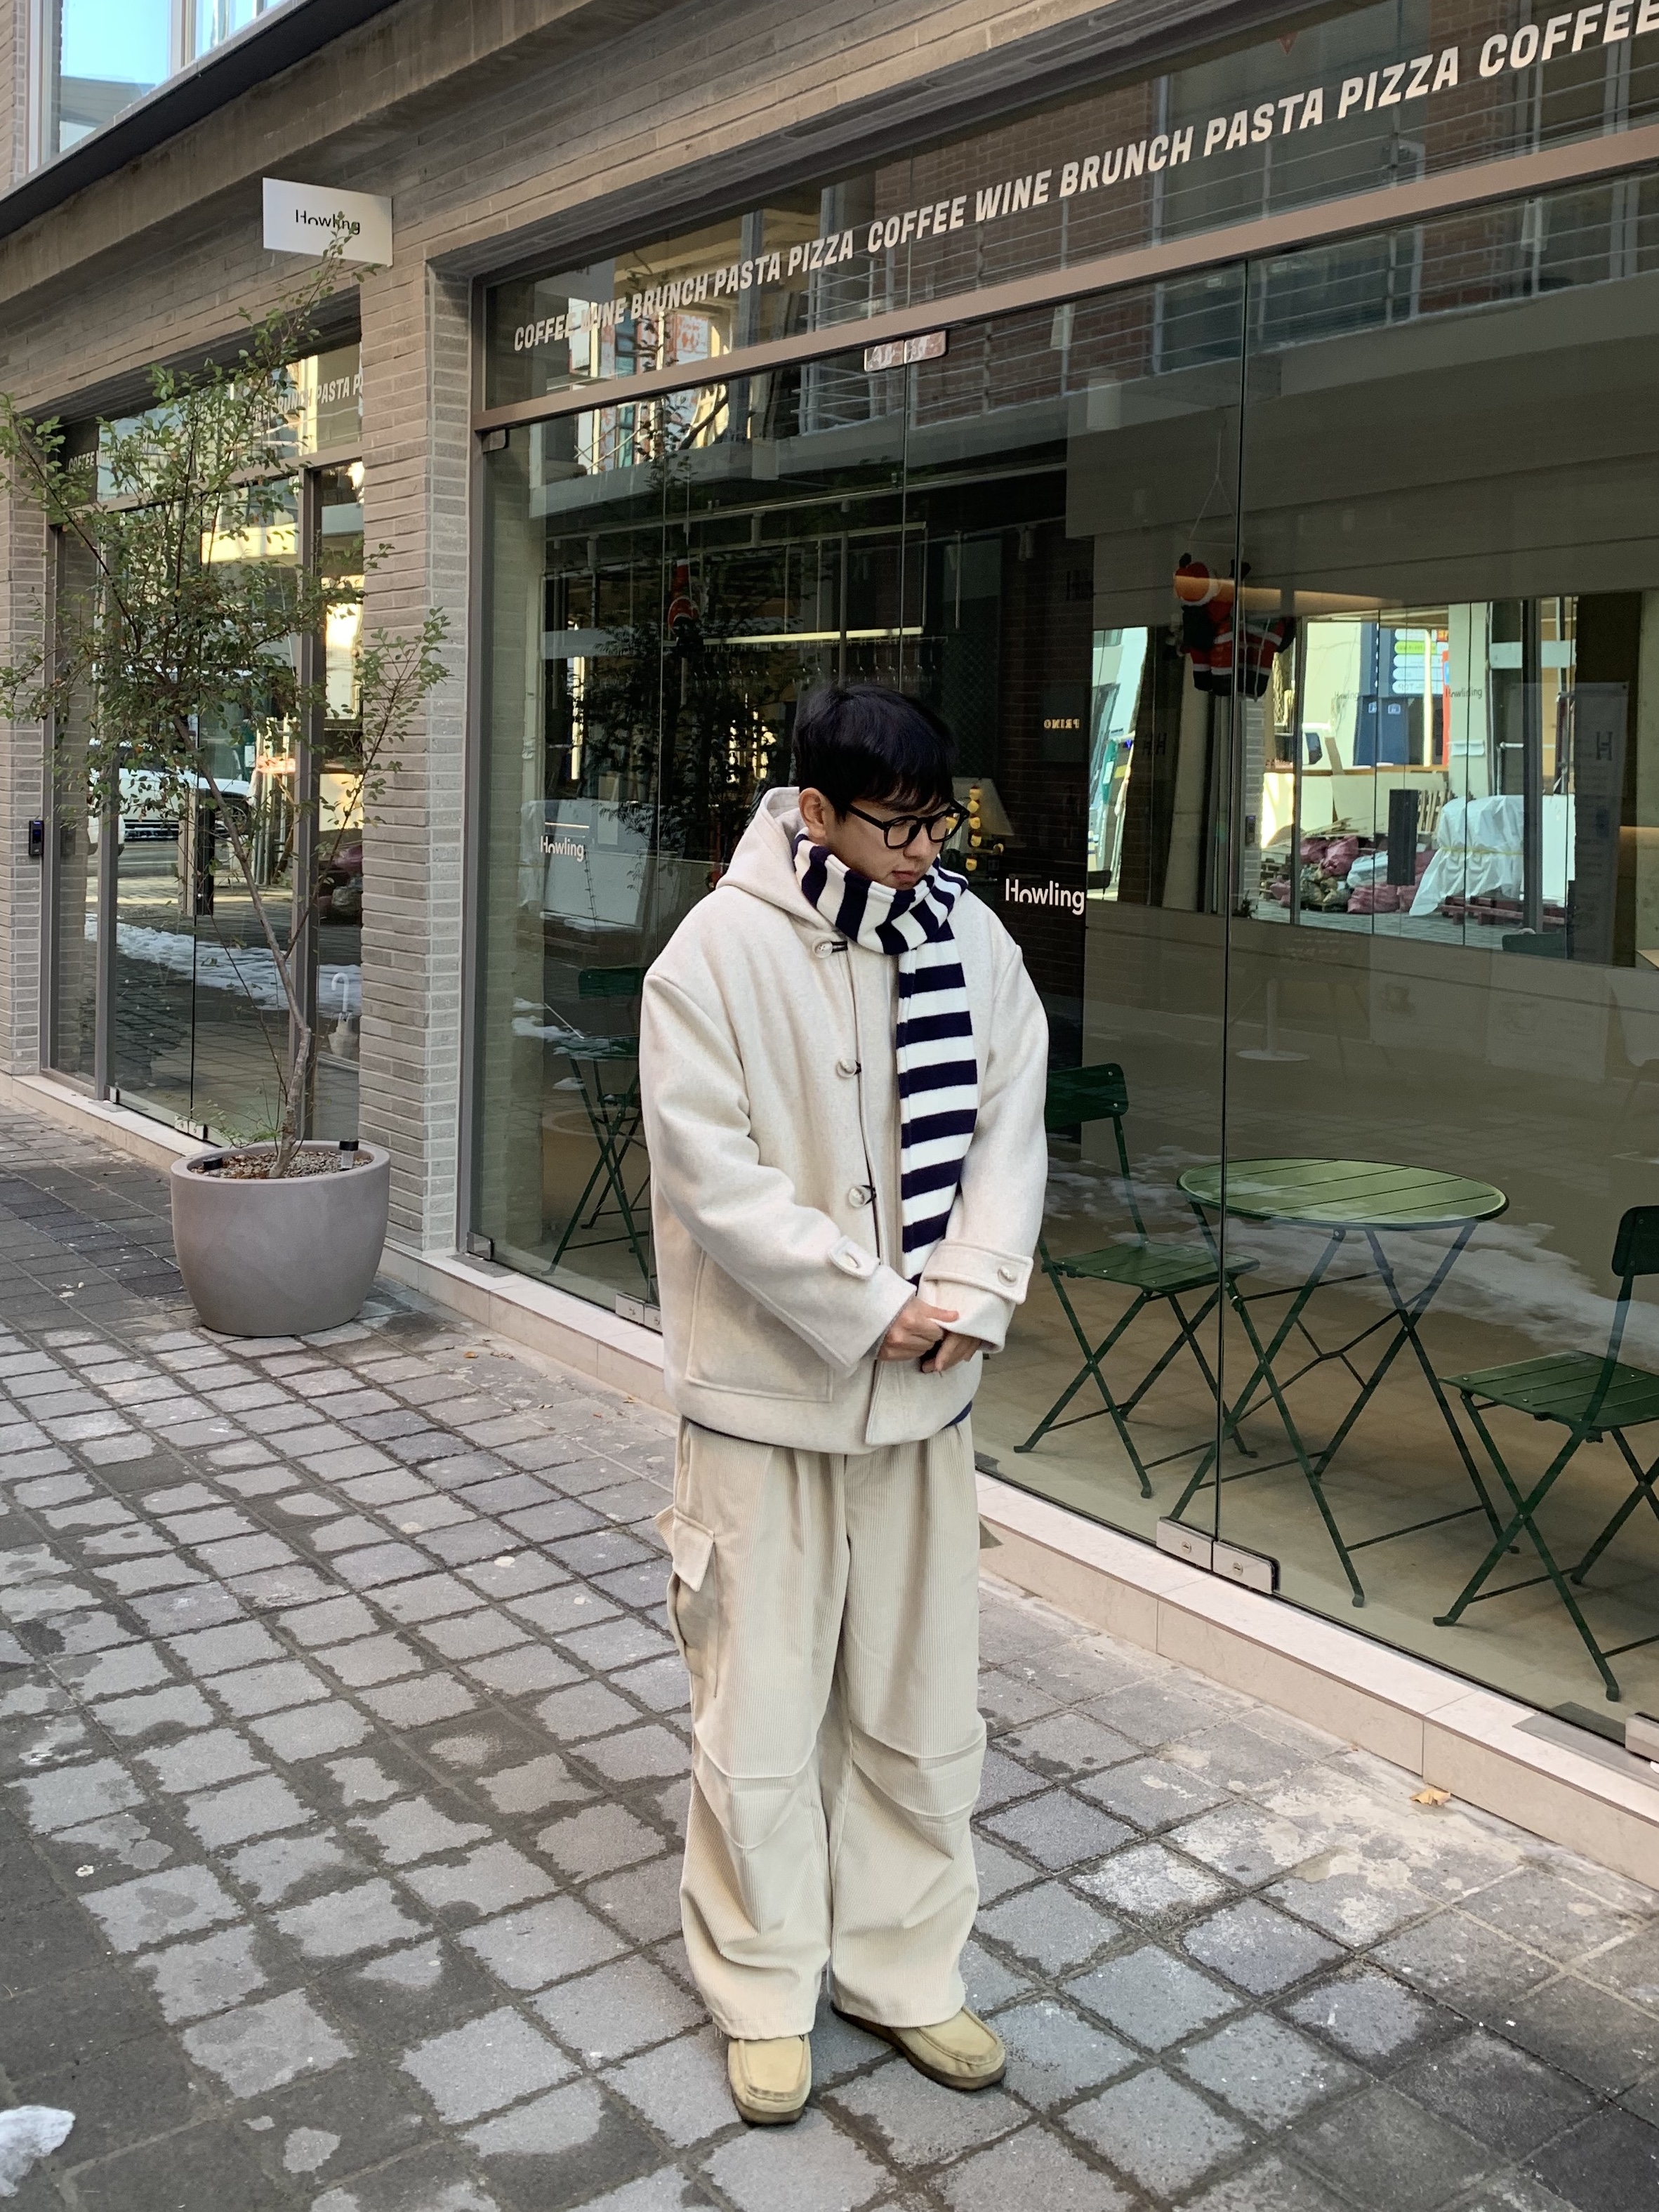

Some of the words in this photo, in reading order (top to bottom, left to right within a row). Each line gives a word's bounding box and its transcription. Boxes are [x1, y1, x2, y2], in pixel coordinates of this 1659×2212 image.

[514, 311, 577, 352] COFFEE
[581, 296, 626, 334] WINE
[631, 274, 709, 317] BRUNCH
[713, 251, 781, 298] PASTA
[788, 230, 854, 277] PIZZA
[867, 195, 967, 253] COFFEE
[975, 169, 1051, 223] WINE
[1060, 125, 1194, 199] BRUNCH
[1203, 88, 1323, 157] PASTA
[1337, 47, 1460, 119] PIZZA
[1479, 0, 1659, 78] COFFEE
[295, 209, 360, 235] Howlng
[316, 375, 350, 406] PASTA
[540, 835, 585, 862] Howling
[1005, 877, 1085, 916] Howling
